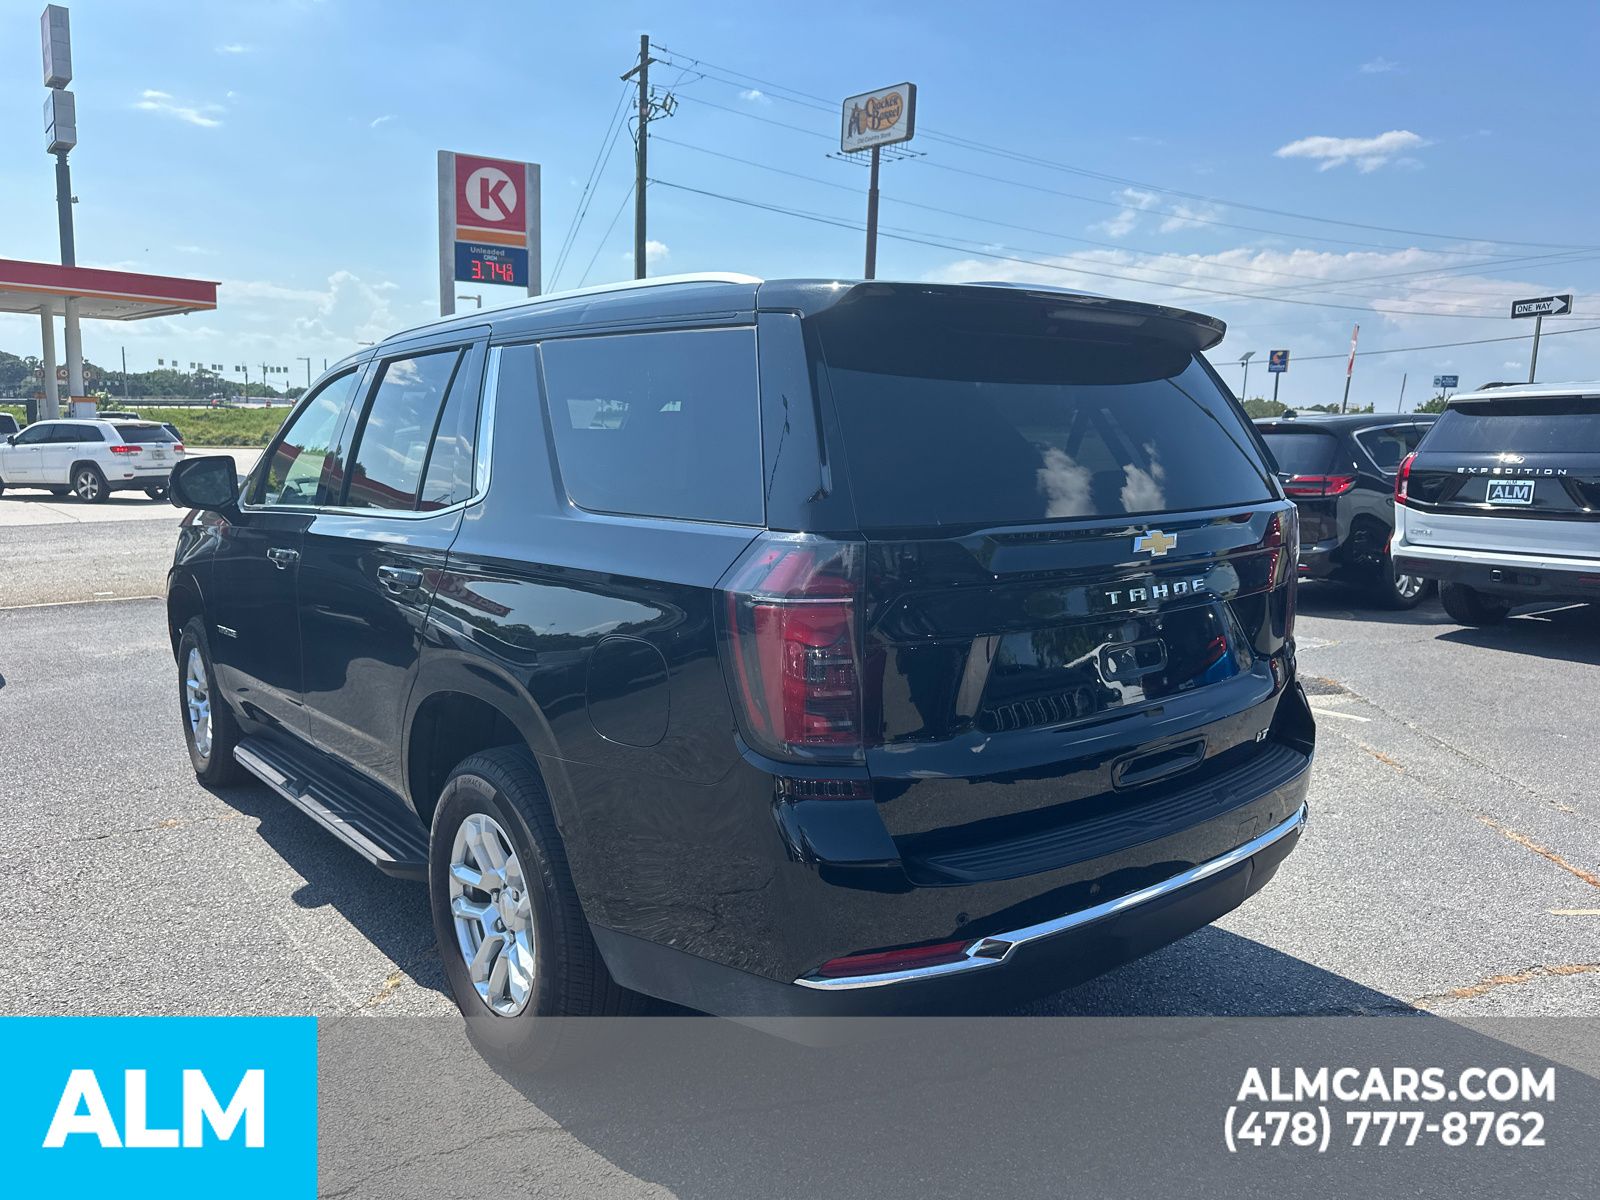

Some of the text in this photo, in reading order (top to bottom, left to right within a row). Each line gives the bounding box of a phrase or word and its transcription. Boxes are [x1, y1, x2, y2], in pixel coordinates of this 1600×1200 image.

[480, 177, 513, 219] K
[470, 246, 505, 257] Unleaded
[1517, 302, 1551, 313] ONE WAY
[1457, 467, 1567, 475] EXPEDITION
[1492, 485, 1529, 499] ALM
[1105, 578, 1207, 605] TAHOE
